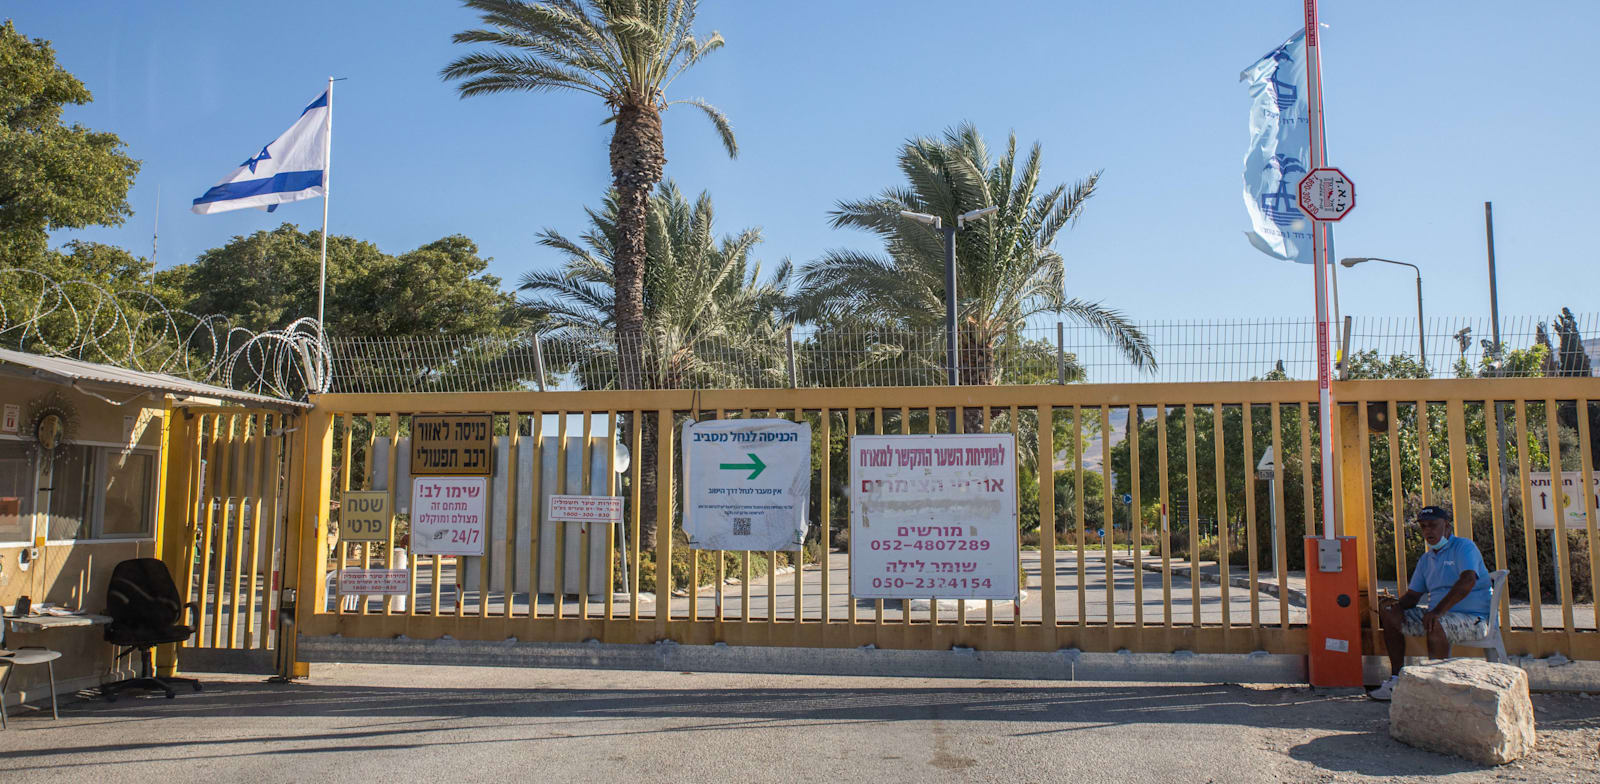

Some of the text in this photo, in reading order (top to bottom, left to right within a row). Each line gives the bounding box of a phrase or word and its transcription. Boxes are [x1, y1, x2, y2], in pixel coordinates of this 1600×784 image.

[418, 420, 486, 441] כניסה לאזור
[693, 431, 798, 442] הכניסה לנחל מסביב
[417, 447, 486, 467] רכב תפעולי
[860, 444, 1005, 470] לפתיחת השער התקשר למארח
[419, 484, 480, 498] שימו לב!
[726, 488, 737, 496] דרך
[738, 487, 753, 495] לנחל
[347, 498, 383, 513] שטח
[430, 502, 468, 511] מתחם זה
[347, 519, 382, 534] פרטי
[419, 514, 478, 526] מצולם ומוקלט
[451, 528, 480, 545] 24/7
[897, 526, 962, 536] מורשים
[870, 539, 990, 551] 052-4807289
[886, 560, 977, 573] שומר לילה
